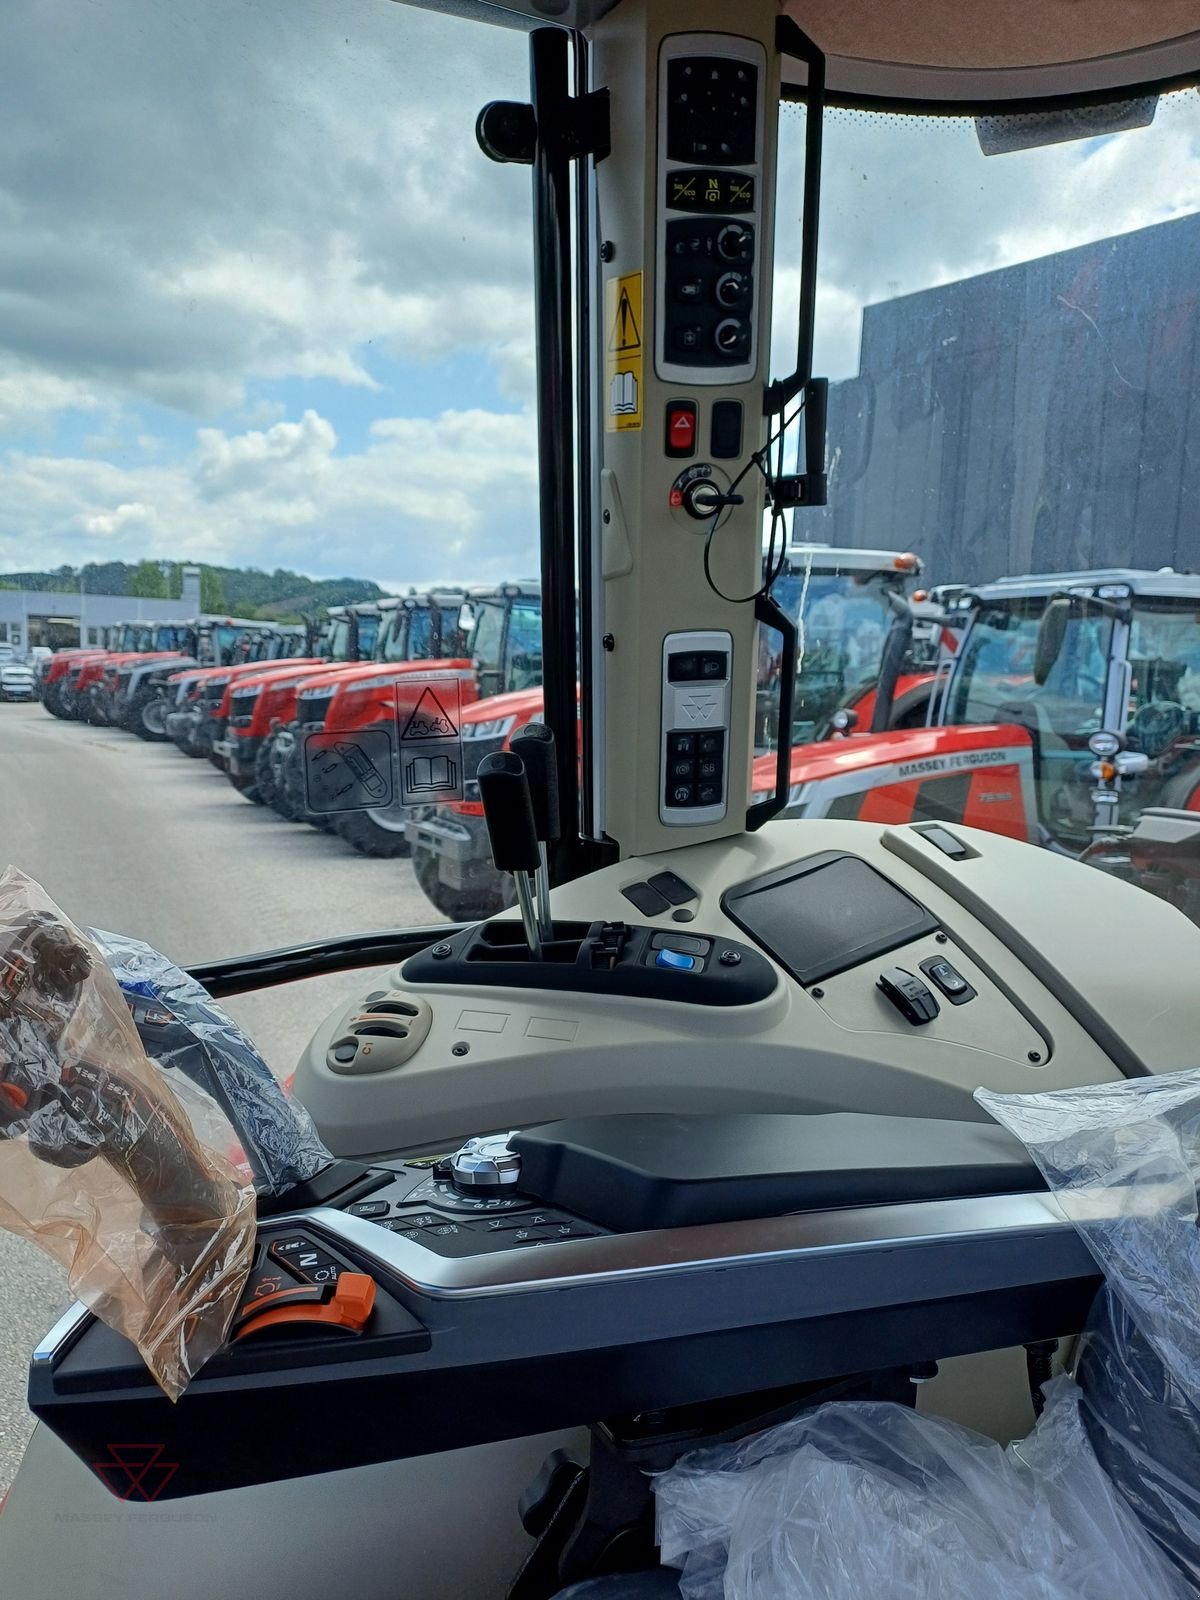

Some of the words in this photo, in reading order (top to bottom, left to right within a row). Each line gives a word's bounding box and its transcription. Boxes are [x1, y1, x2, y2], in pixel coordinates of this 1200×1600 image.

[708, 178, 719, 189] N
[899, 759, 946, 776] MASSEY
[950, 751, 1006, 769] FERGUSON
